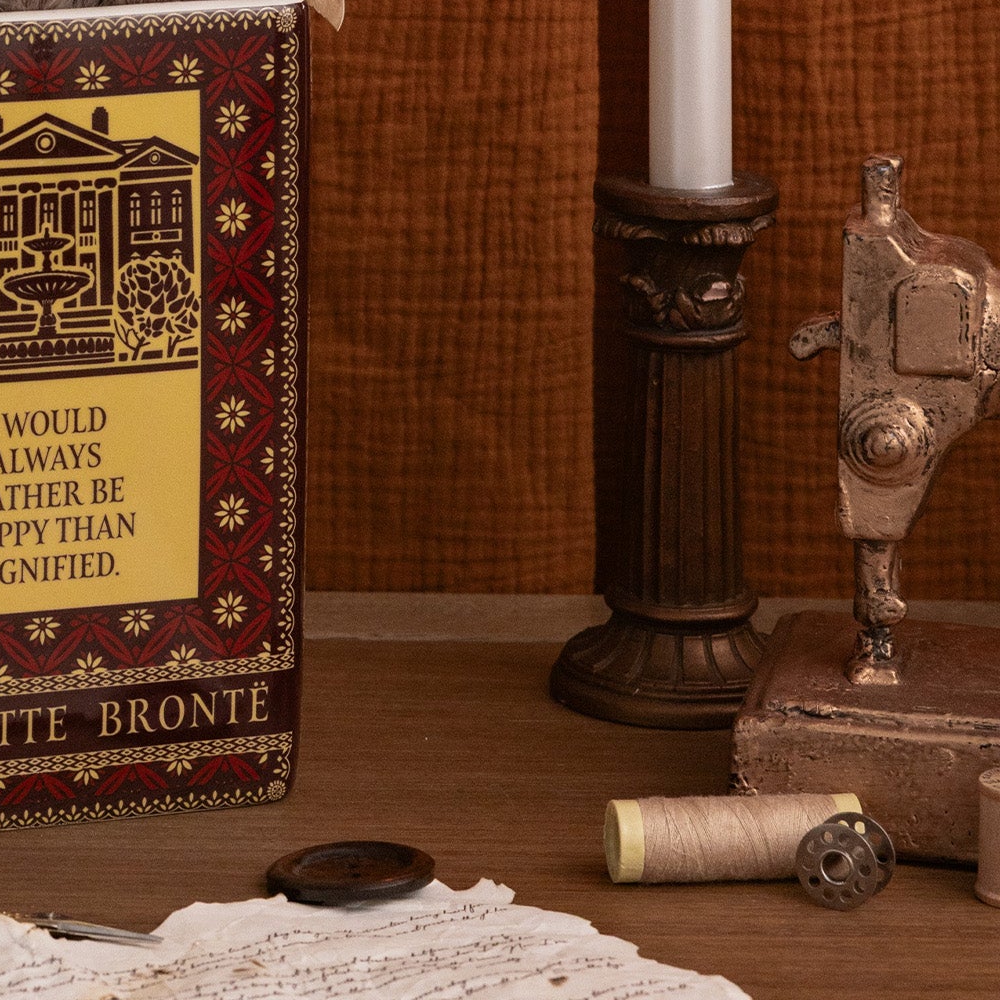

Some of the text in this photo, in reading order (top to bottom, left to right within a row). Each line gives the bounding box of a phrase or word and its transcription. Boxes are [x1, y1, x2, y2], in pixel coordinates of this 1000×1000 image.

[2, 406, 107, 439] WOULD
[90, 476, 125, 505] BE
[55, 511, 136, 544] THAN
[98, 680, 269, 737] BRONTË
